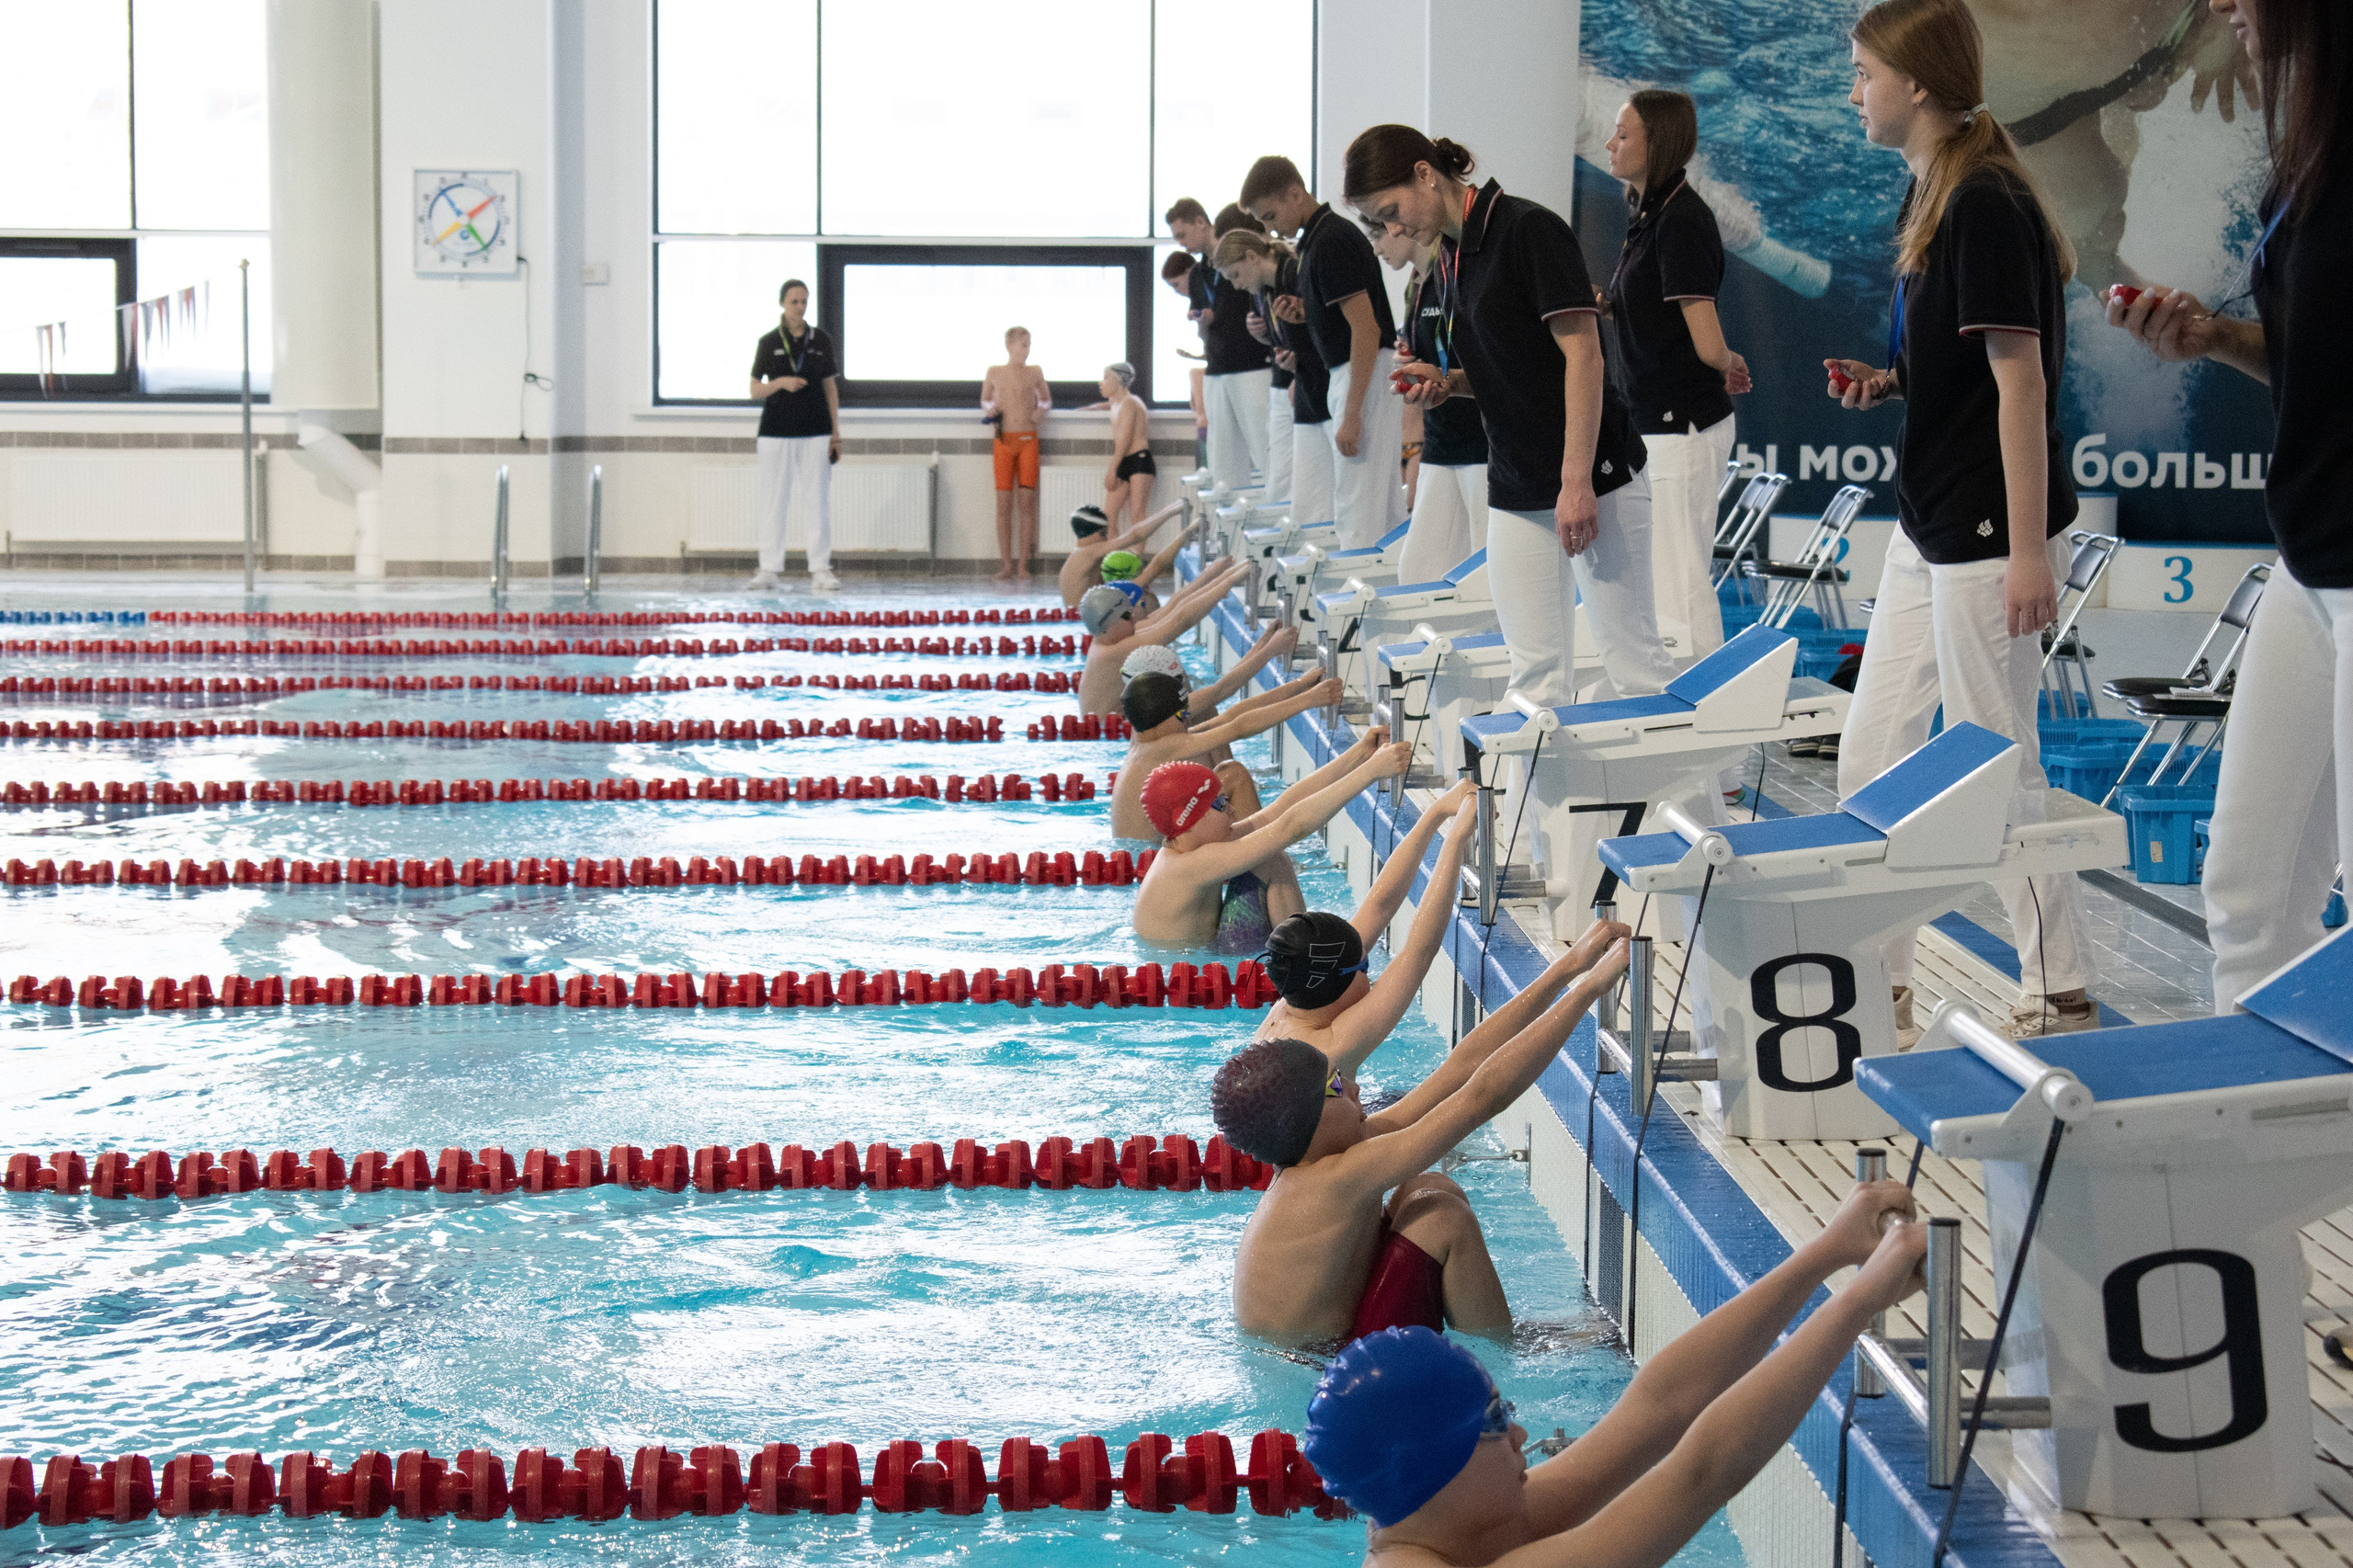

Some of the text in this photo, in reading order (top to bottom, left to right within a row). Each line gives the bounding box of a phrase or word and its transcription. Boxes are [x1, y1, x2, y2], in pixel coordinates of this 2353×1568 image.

[1421, 306, 1443, 317] СУДЬ
[2072, 433, 2272, 489] больш
[2164, 556, 2194, 603] 3
[1176, 796, 1199, 826] arena
[1569, 801, 1647, 909] 7
[1750, 953, 1862, 1092] 8
[2101, 1249, 2268, 1453] 9
